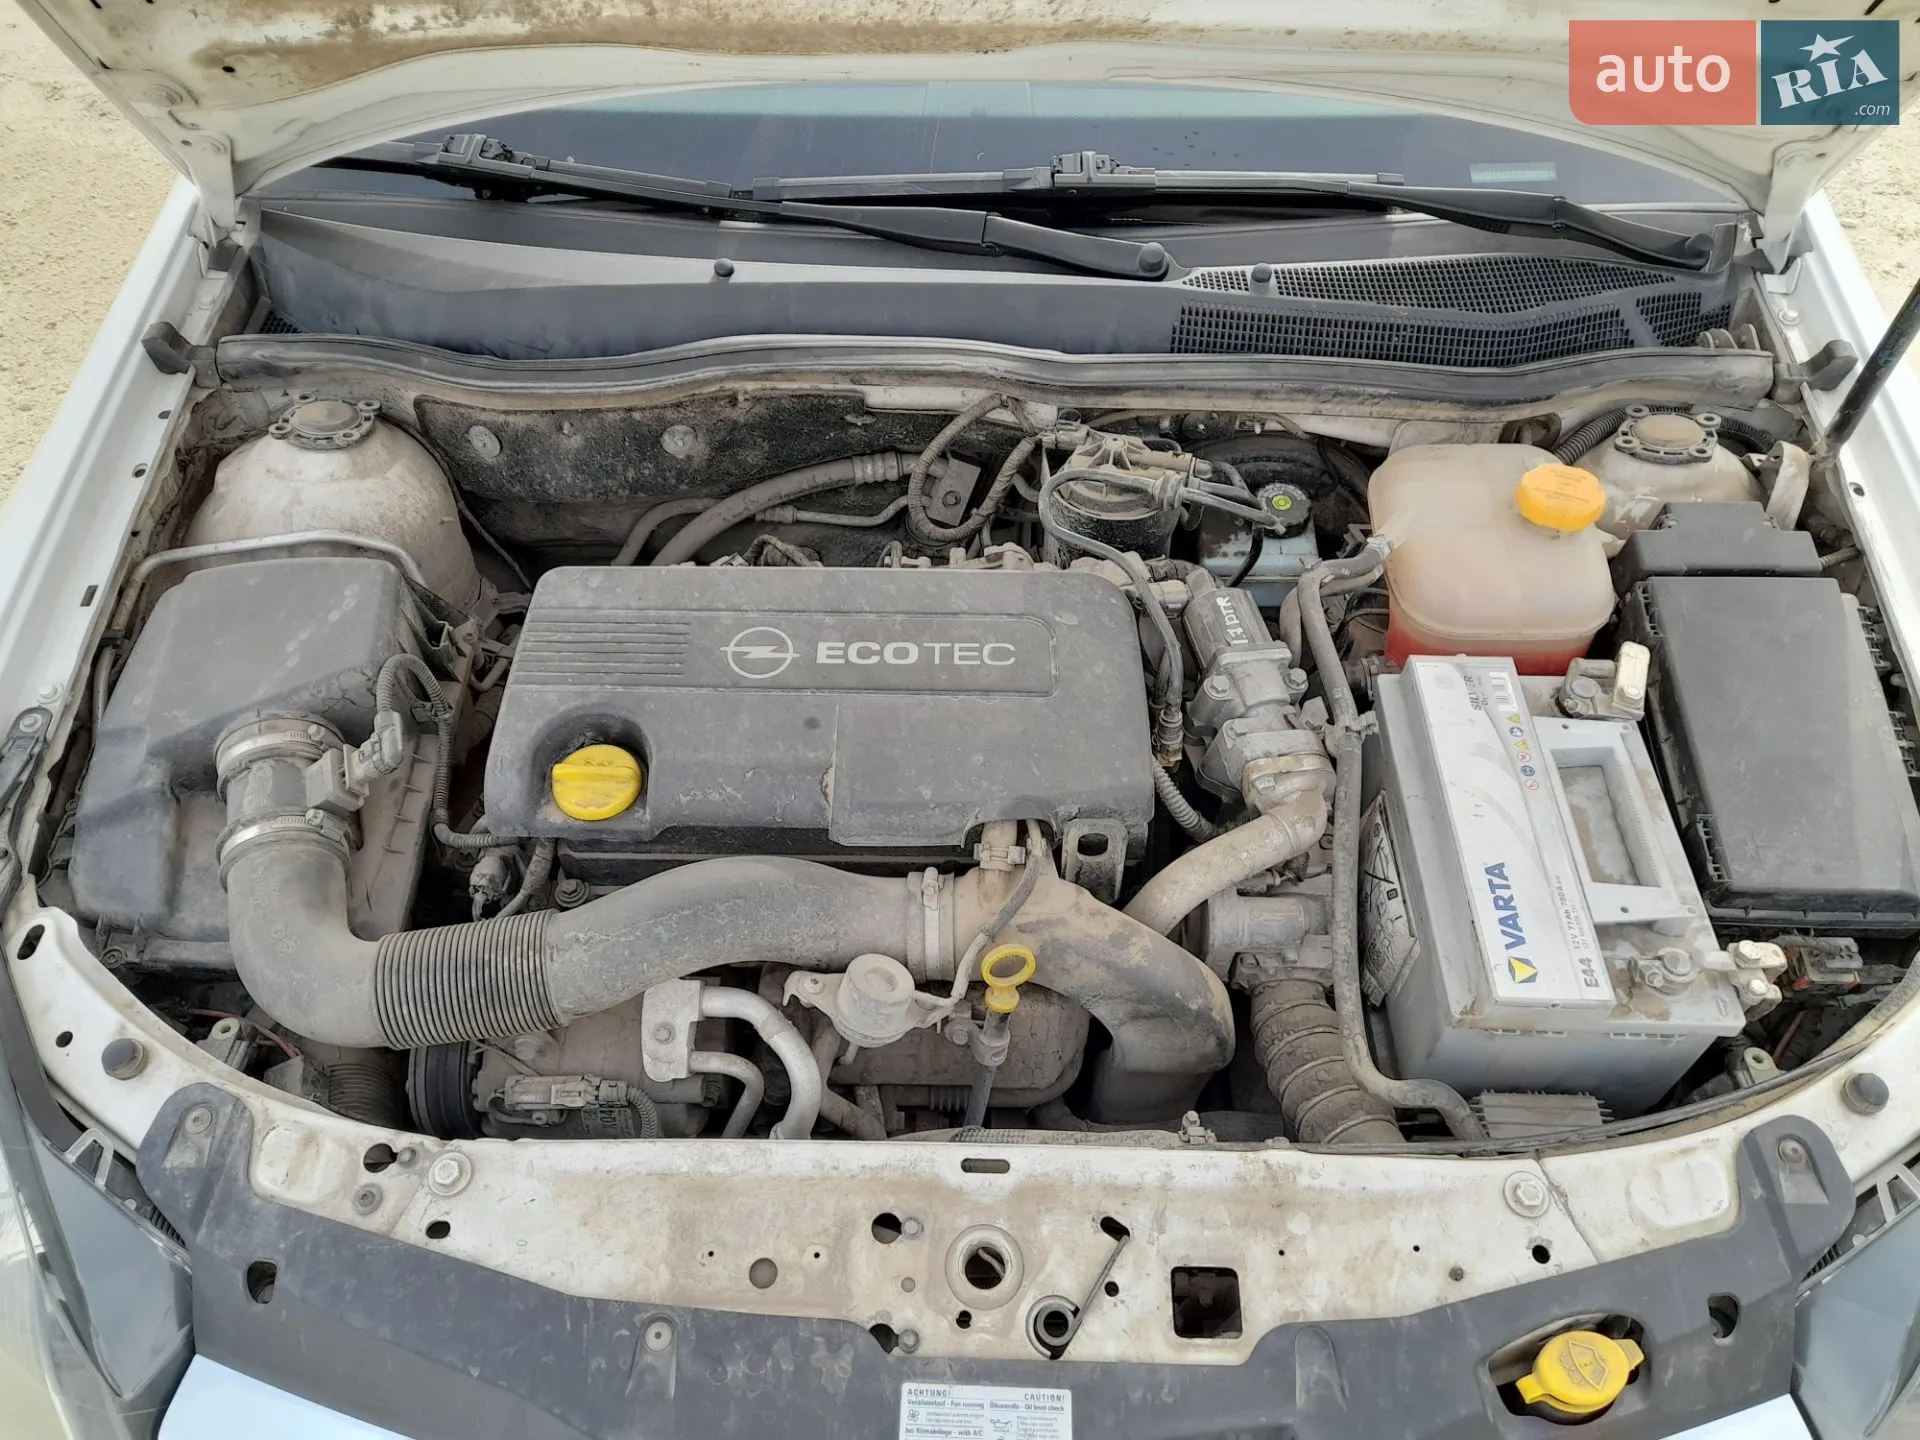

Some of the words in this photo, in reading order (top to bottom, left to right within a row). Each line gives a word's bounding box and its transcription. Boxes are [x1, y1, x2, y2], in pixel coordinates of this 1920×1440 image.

[816, 641, 1016, 665] ECOTEC
[1464, 675, 1482, 711] SILVER
[1485, 862, 1526, 950] VARTA
[1578, 957, 1600, 988] E44
[907, 1388, 951, 1398] ACHTUNG!
[1024, 1393, 1065, 1402] CAUTION!
